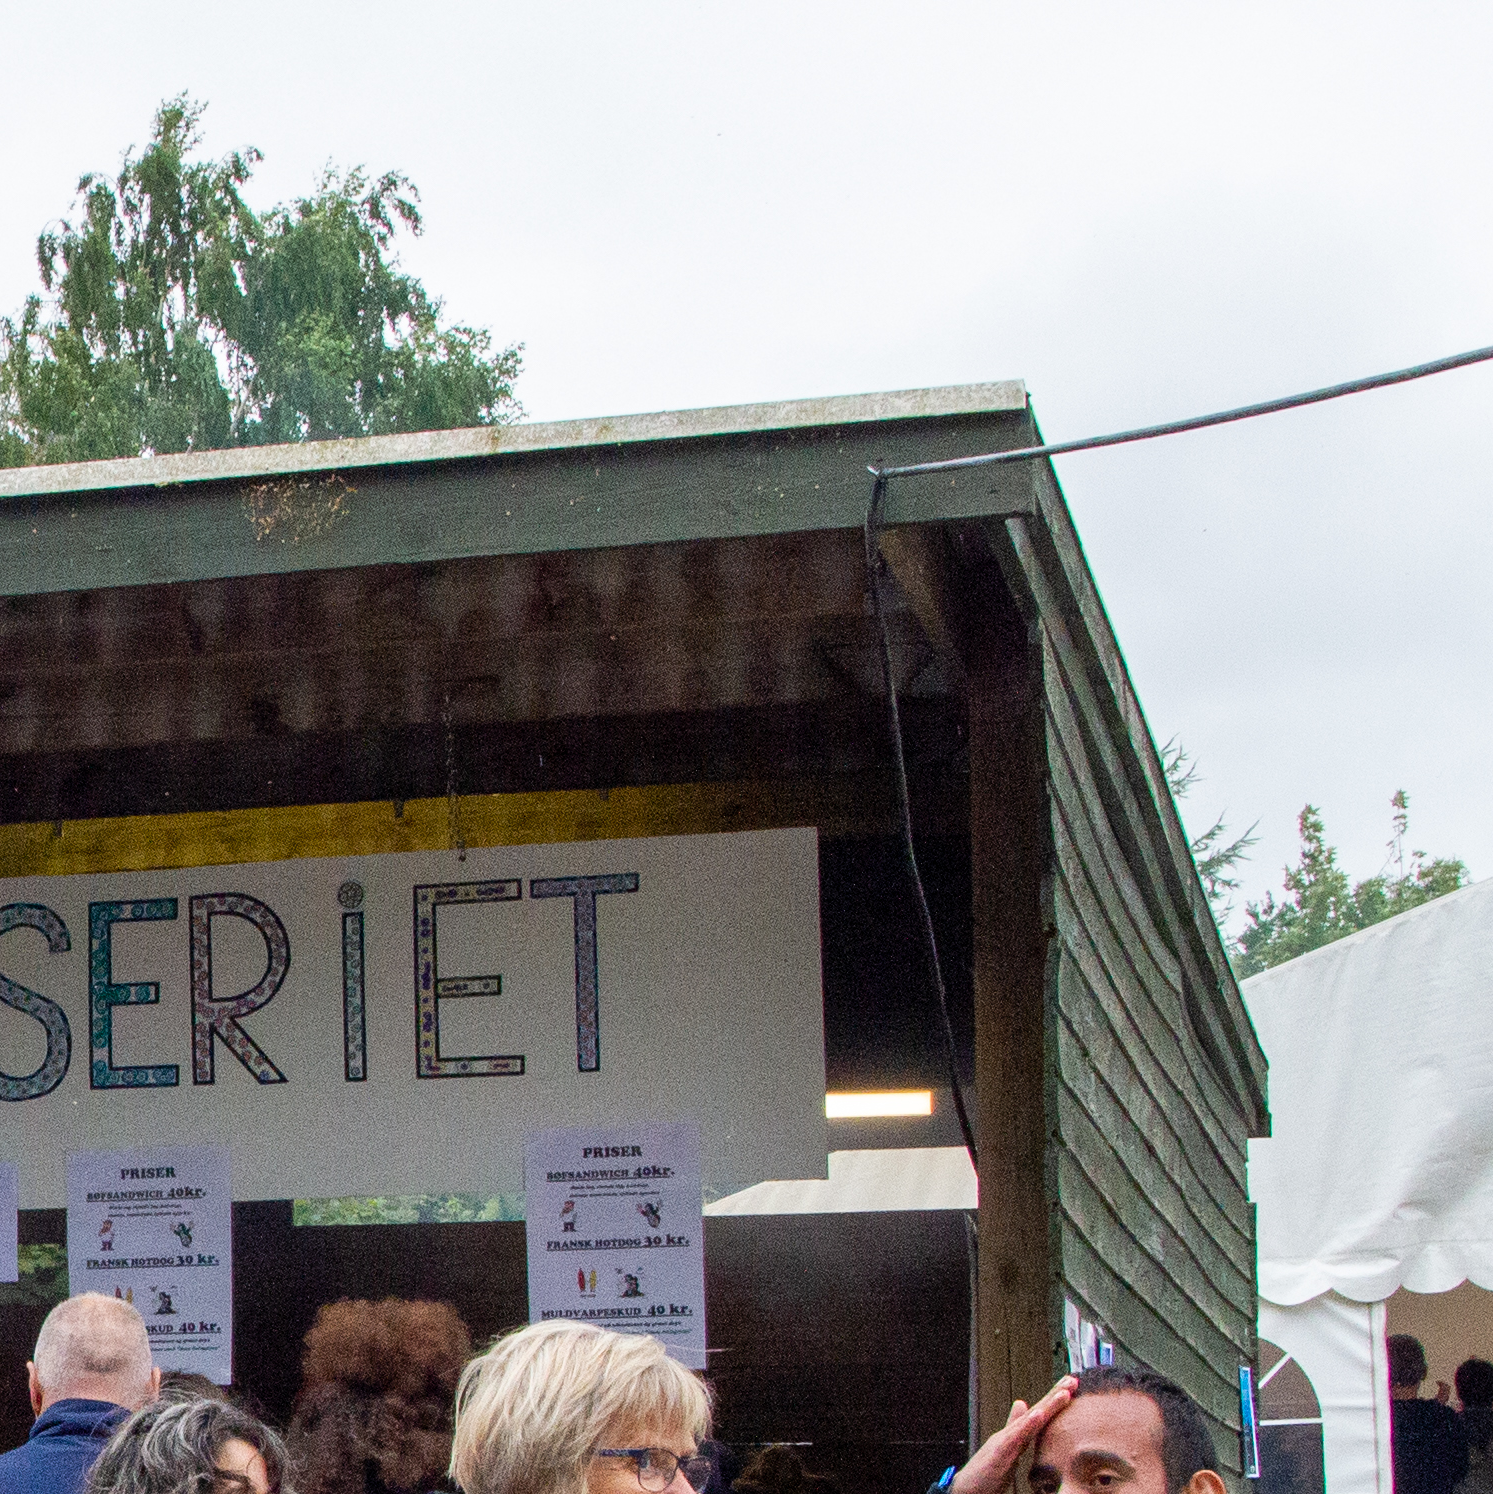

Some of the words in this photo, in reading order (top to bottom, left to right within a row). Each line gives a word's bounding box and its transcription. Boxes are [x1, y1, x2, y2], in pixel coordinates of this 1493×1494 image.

[582, 1145, 642, 1158] PRISER
[121, 1167, 176, 1180] PRISER
[547, 1240, 592, 1250] FRANSK
[595, 1238, 641, 1248] HOTDOG
[644, 1236, 662, 1246] 30
[87, 1259, 129, 1268] FRANSK
[131, 1257, 174, 1267] HOTDOG
[176, 1255, 193, 1265] 30
[647, 1304, 665, 1316] 40
[179, 1322, 195, 1333] 40
